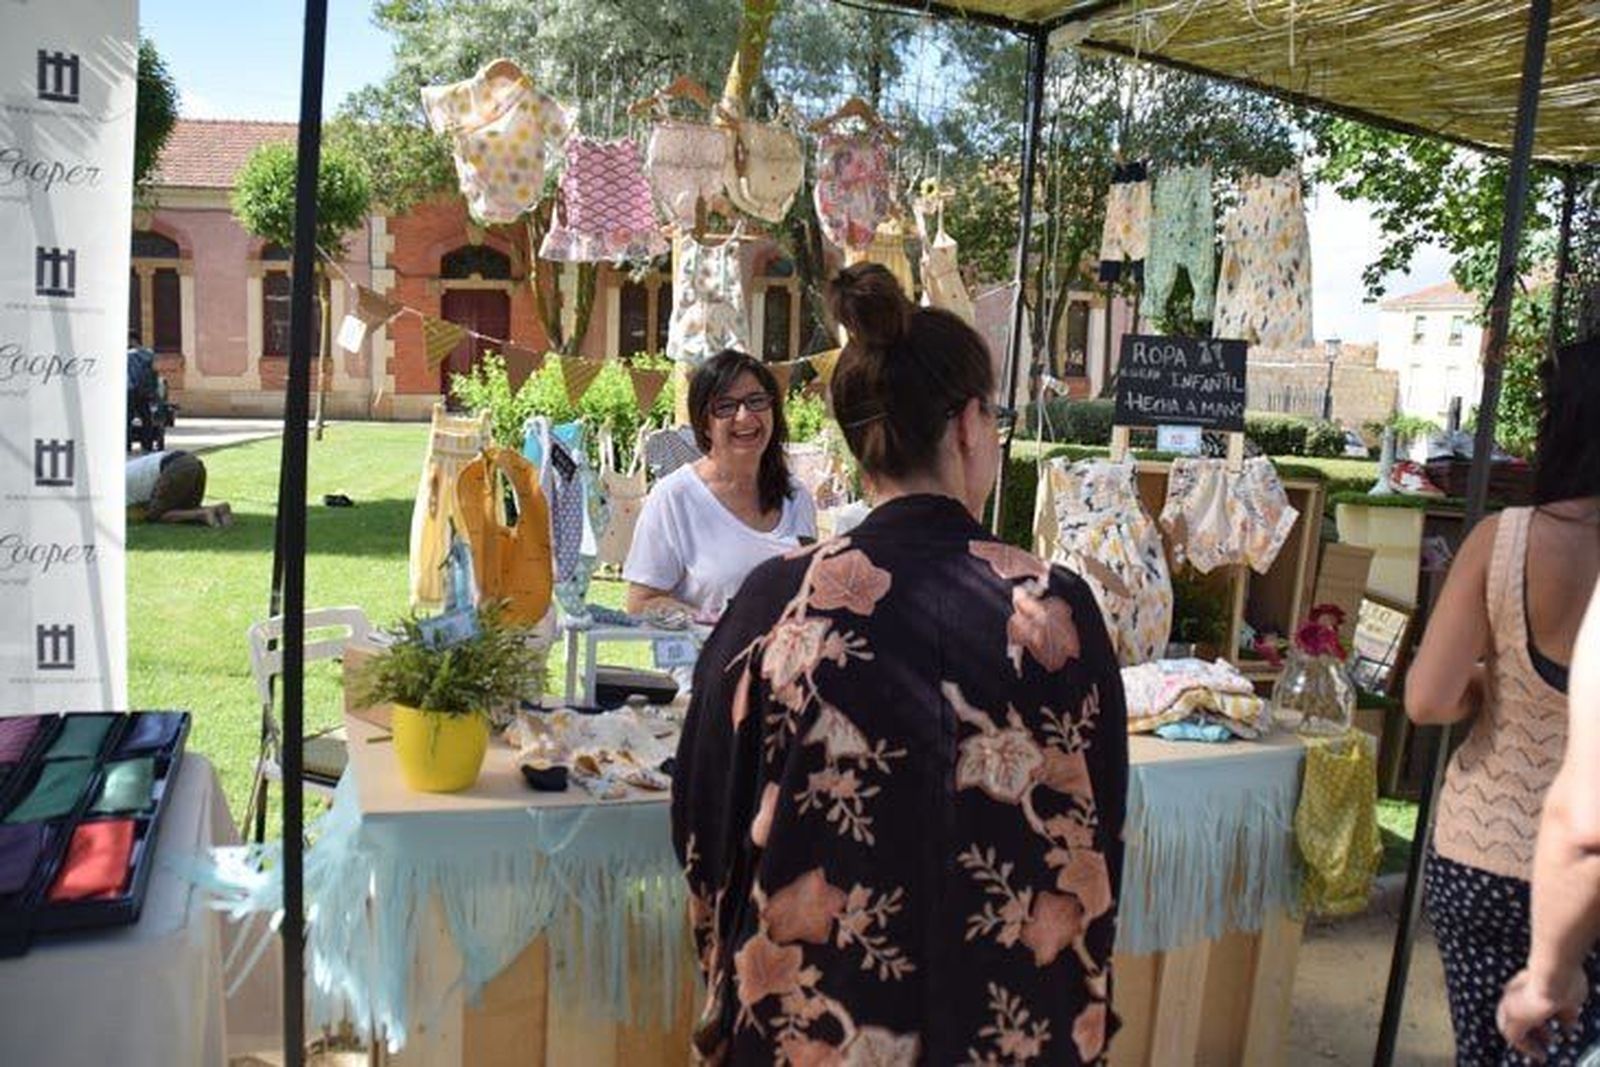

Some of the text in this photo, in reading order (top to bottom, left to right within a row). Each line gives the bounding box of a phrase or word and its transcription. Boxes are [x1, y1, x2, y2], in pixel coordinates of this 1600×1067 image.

[1131, 341, 1188, 369] ROPA
[1171, 371, 1244, 394] INFANTIL
[1124, 390, 1181, 415] HECHA
[1185, 400, 1199, 416] A
